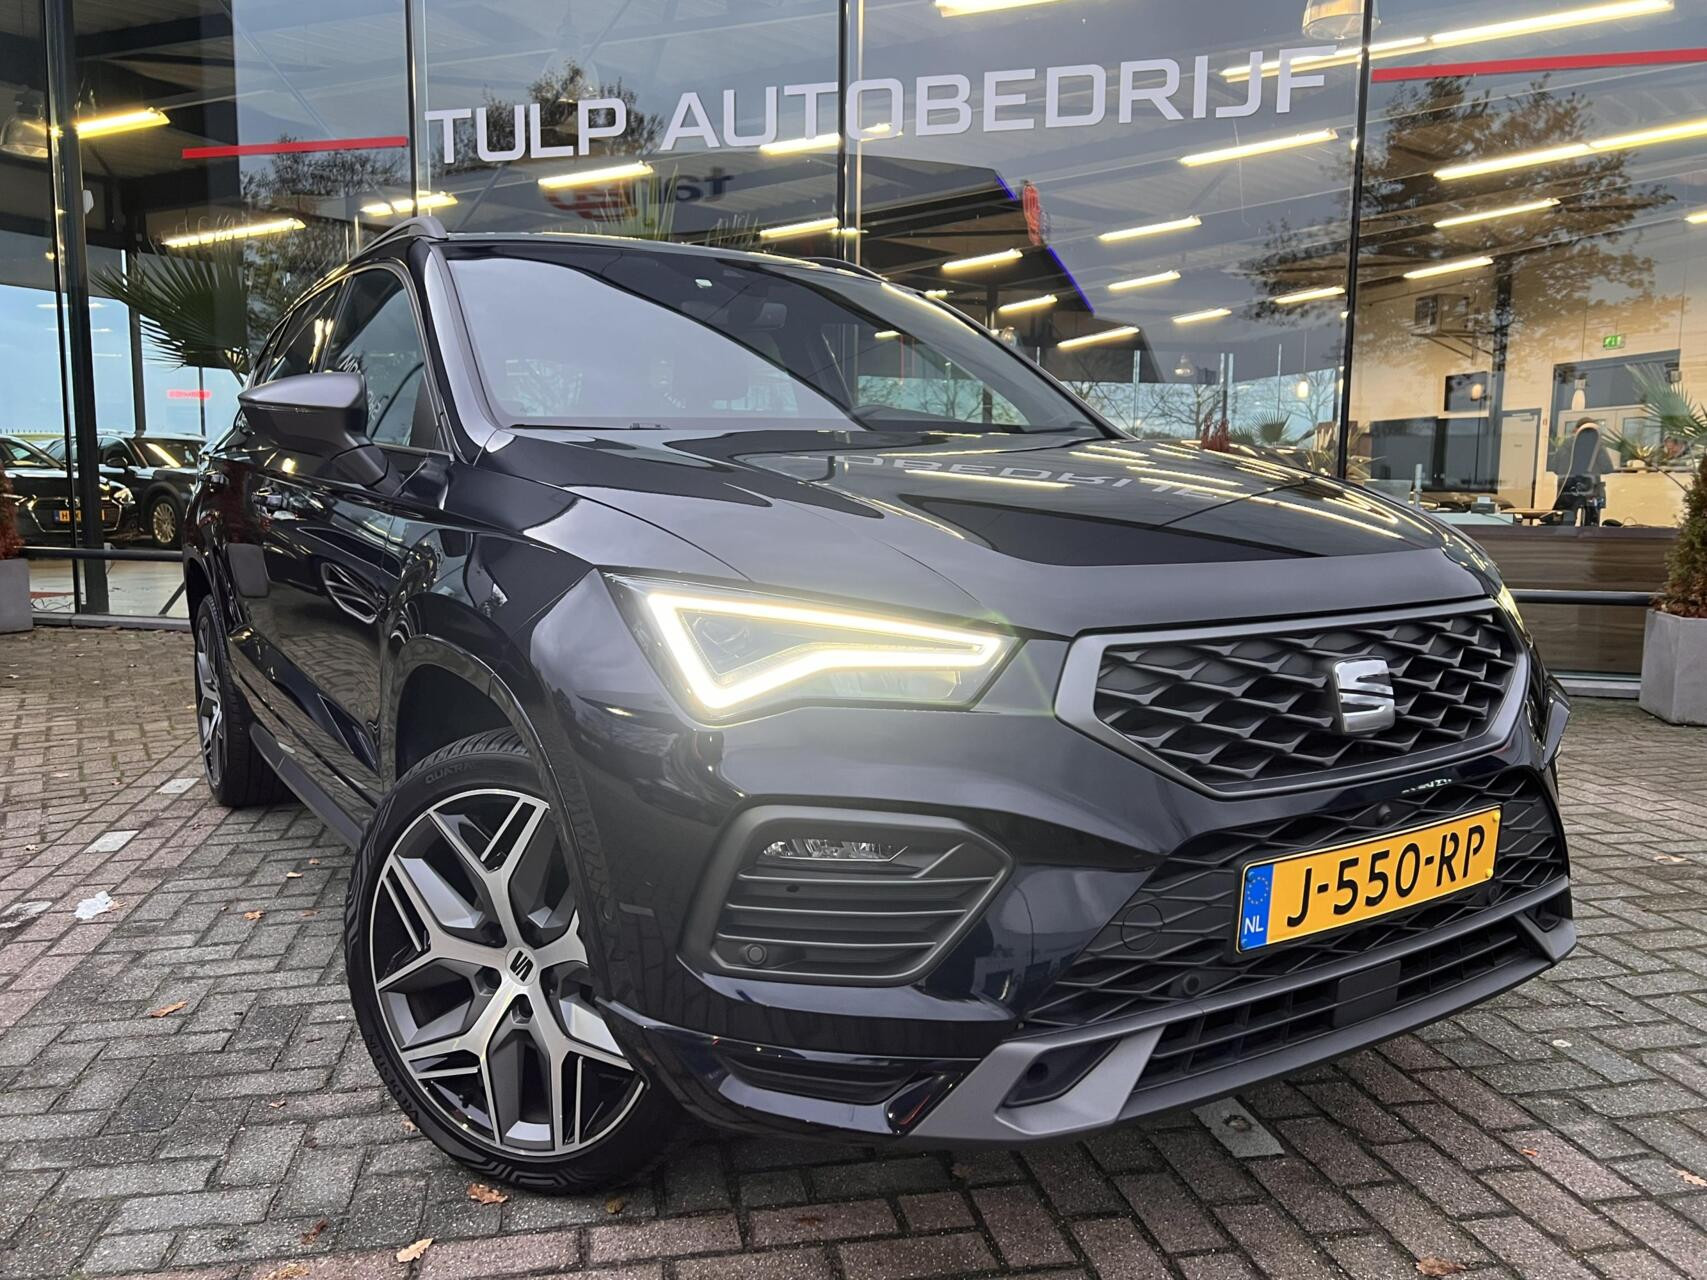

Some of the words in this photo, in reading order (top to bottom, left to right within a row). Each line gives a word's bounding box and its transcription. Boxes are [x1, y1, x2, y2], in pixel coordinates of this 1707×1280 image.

[424, 97, 627, 164] TULP
[660, 45, 1337, 151] AUTOBEDRIJF
[1244, 915, 1264, 935] NL
[1286, 824, 1486, 928] J-550-RP
